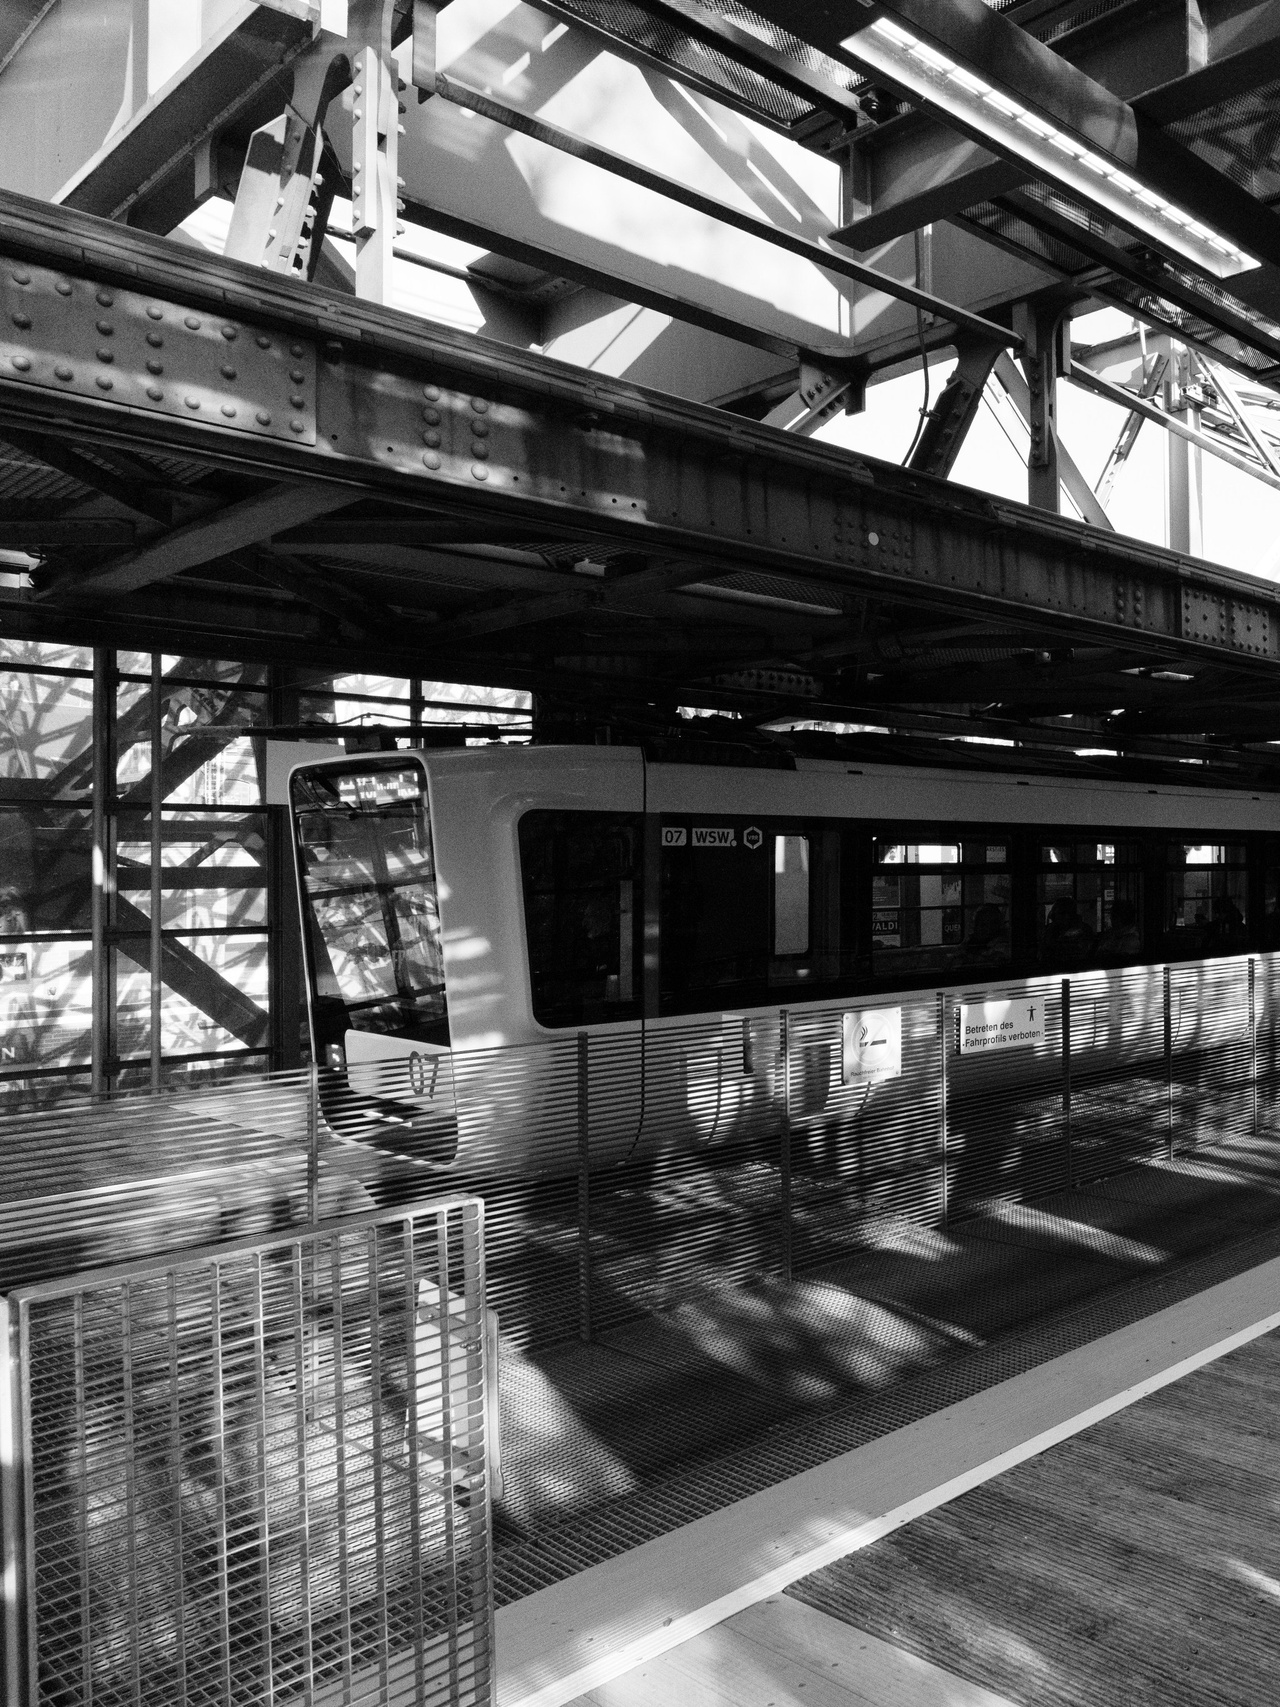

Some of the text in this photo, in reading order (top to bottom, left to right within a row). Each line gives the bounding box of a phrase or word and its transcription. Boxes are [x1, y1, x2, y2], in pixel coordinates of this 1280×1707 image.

[664, 830, 683, 844] 07
[965, 1020, 1014, 1035] Betreten des
[965, 1030, 1041, 1048] Fahrprofils verboten
[409, 1051, 440, 1099] 07
